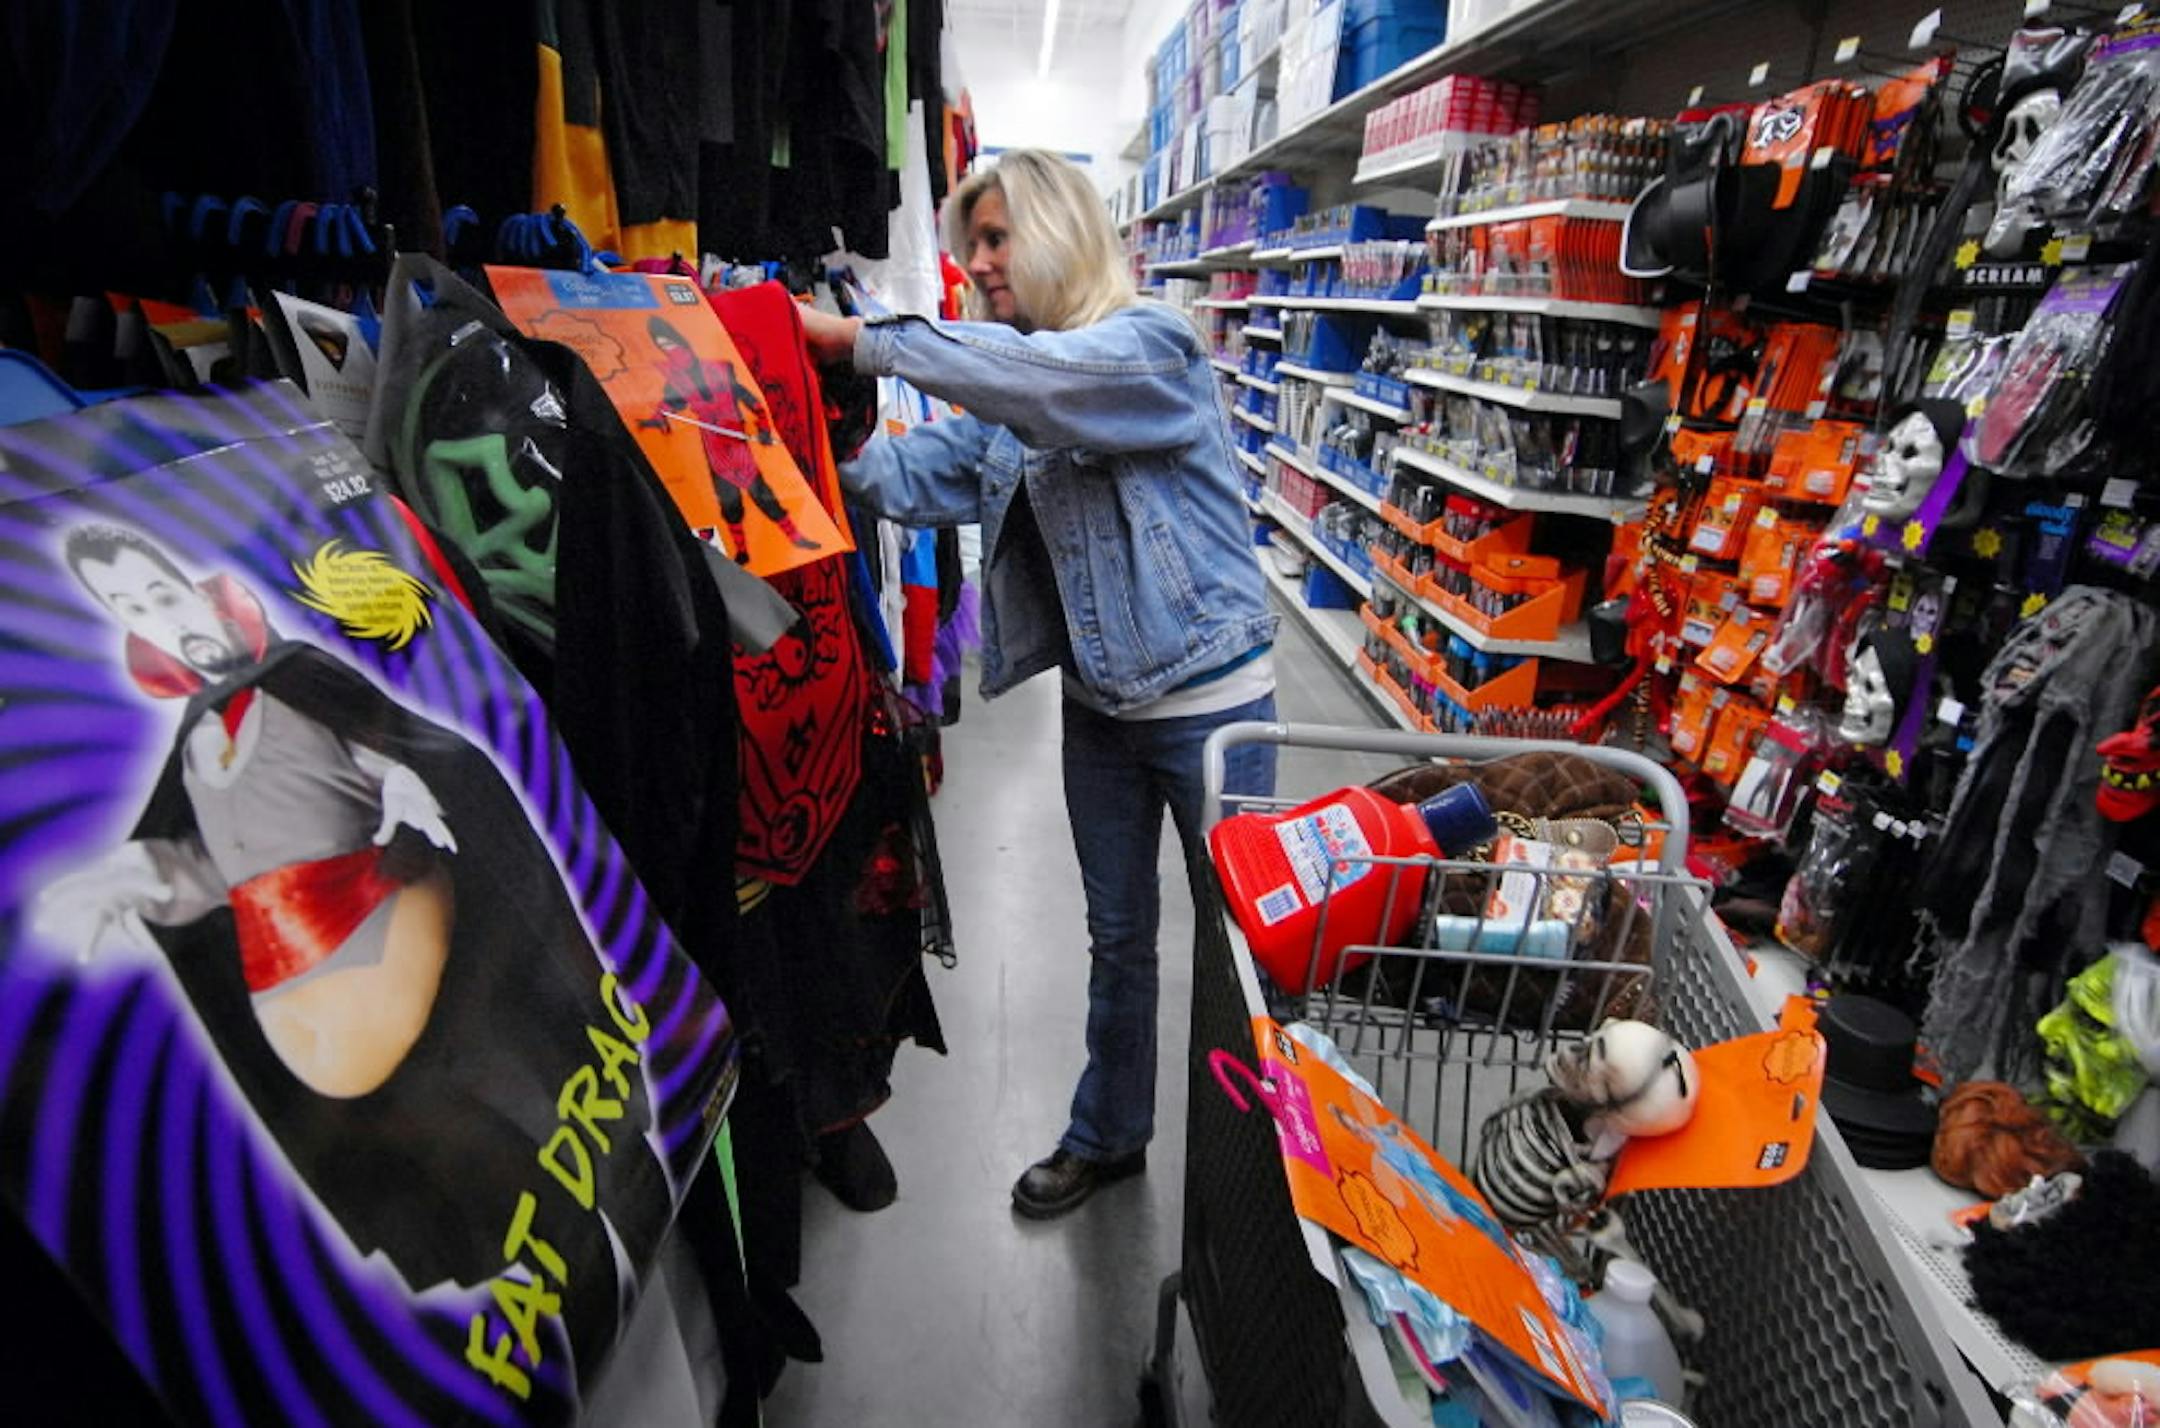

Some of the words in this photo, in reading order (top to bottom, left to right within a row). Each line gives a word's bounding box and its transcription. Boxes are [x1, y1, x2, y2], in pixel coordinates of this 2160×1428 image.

[1965, 267, 2043, 284] SCREAM
[466, 1191, 568, 1400] FAT
[538, 973, 650, 1210] DRAC
